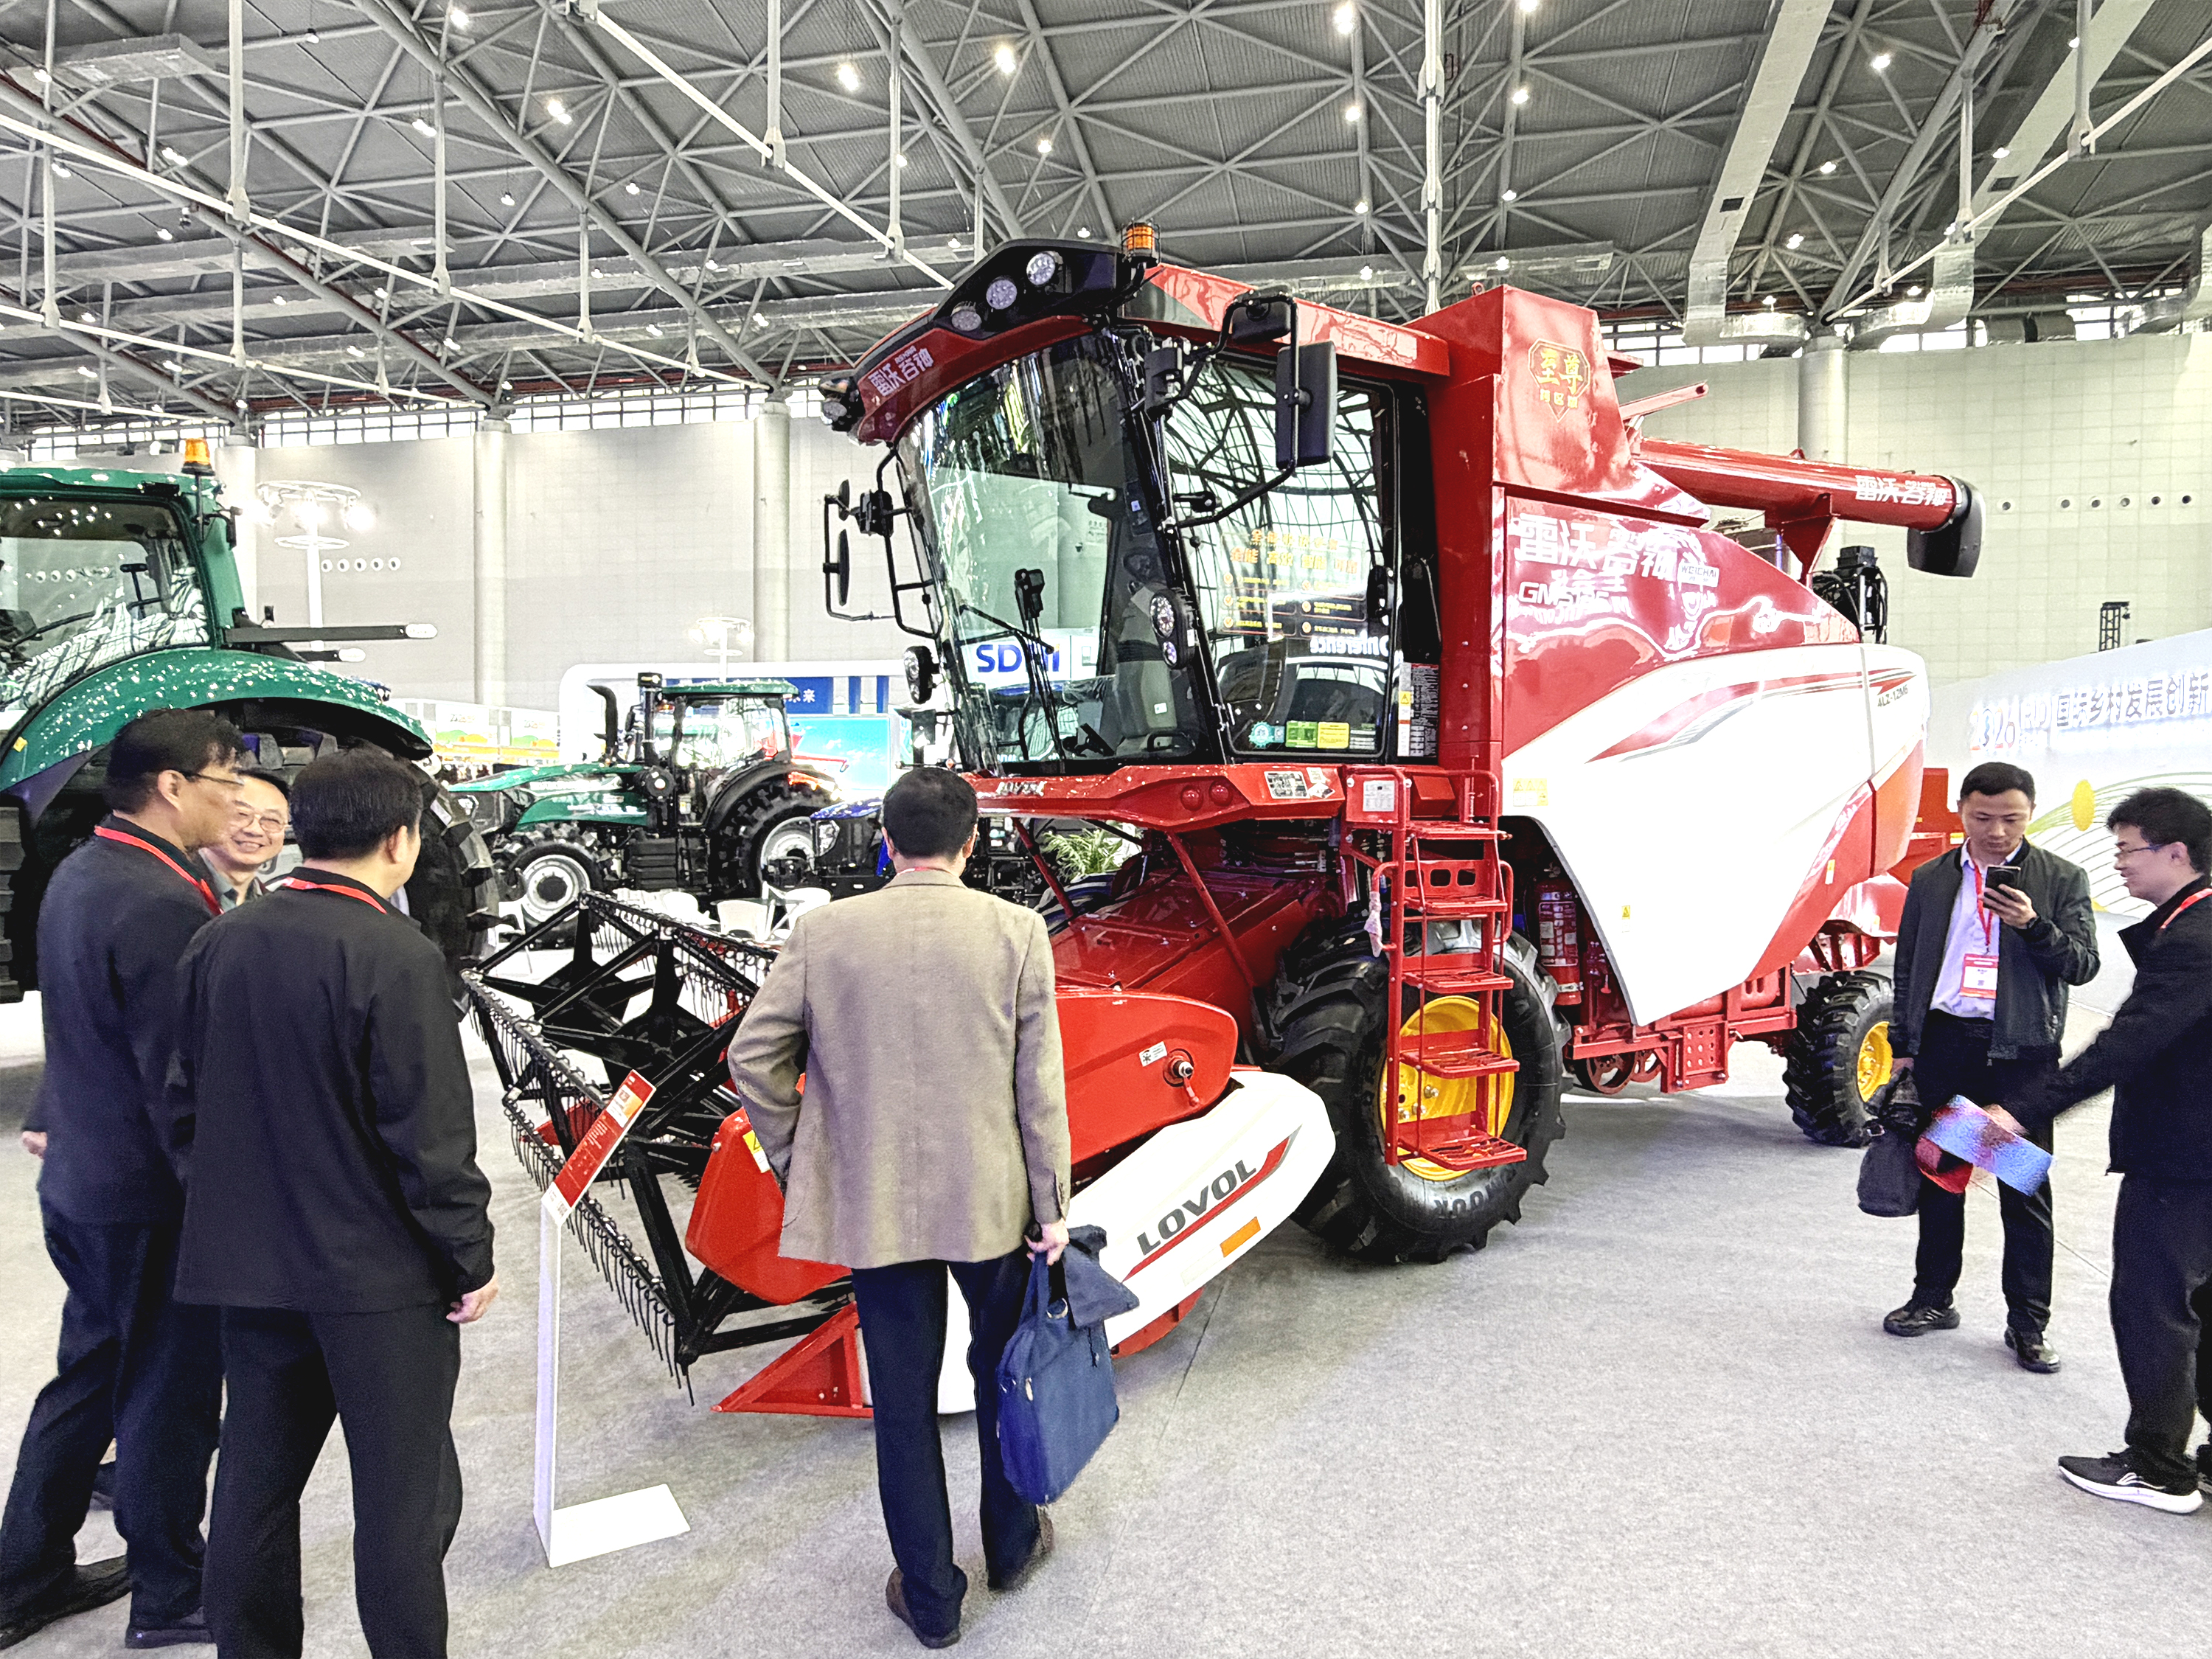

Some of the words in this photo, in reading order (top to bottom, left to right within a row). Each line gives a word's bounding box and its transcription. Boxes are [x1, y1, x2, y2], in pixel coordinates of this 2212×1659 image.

[868, 348, 933, 397] 雷沃谷神
[1536, 348, 1583, 395] 至尊
[1855, 475, 1952, 507] 雷沃谷神
[1517, 513, 1677, 582] 雷沃谷神
[1681, 565, 1717, 578] WEICHAI
[1137, 1159, 1257, 1256] LOVOL
